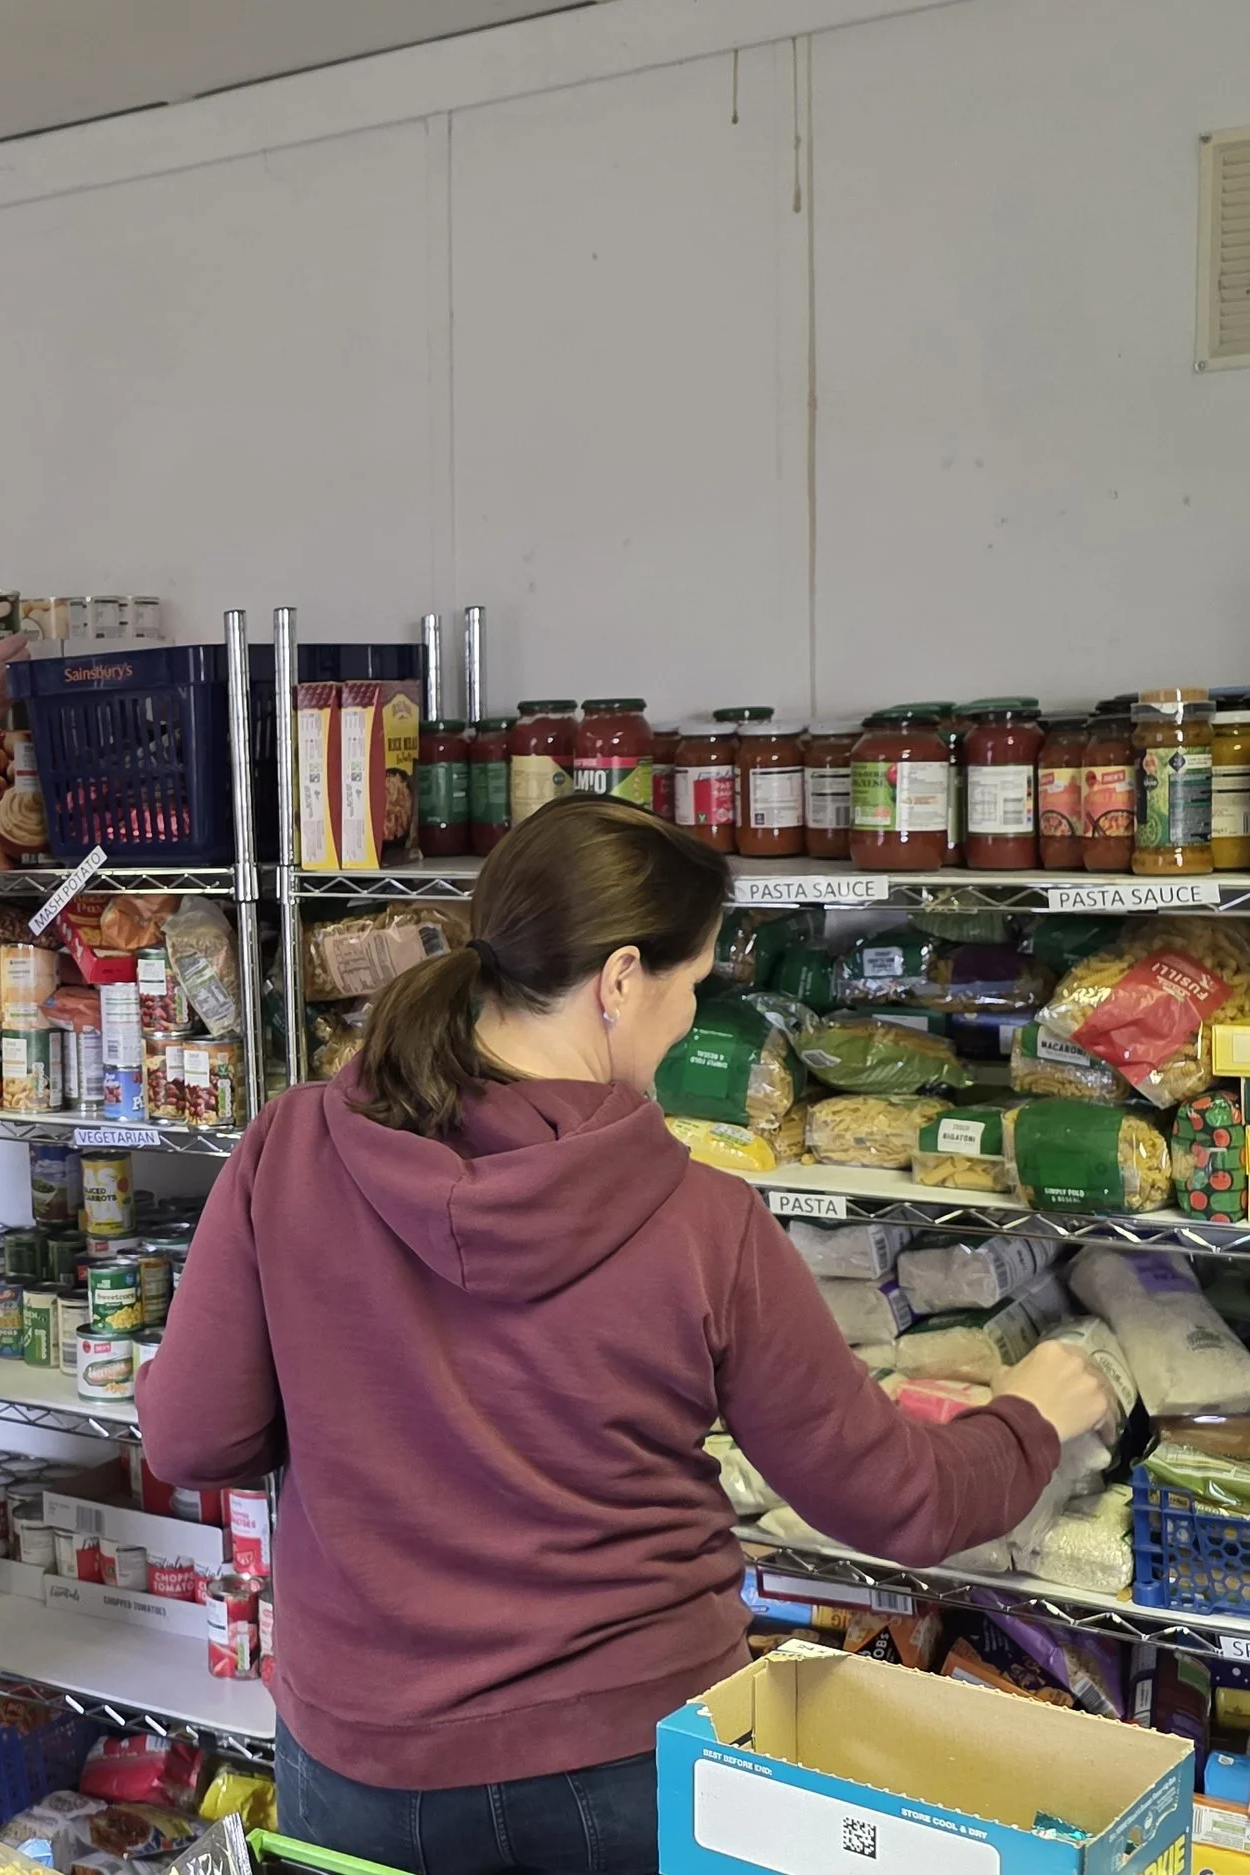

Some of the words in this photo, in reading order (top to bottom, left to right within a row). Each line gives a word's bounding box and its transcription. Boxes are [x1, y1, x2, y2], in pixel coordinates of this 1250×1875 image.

[65, 662, 133, 683] Sainsbury's
[34, 899, 63, 929] MASH
[65, 852, 101, 898] POTATO
[750, 883, 807, 899] PASTA
[813, 881, 875, 897] SAUCE
[1060, 891, 1125, 908] PASTA
[1131, 886, 1201, 905] SAUCE
[1152, 963, 1209, 1001] FUSILLI
[79, 1130, 156, 1144] VEGETARIAN
[779, 1197, 838, 1216] PASTA
[104, 1596, 132, 1610] CHOPPED
[134, 1601, 167, 1617] TOMATOES
[703, 1748, 722, 1760] BEST
[723, 1752, 753, 1770] BEFORE
[754, 1760, 773, 1776] END:
[901, 1807, 932, 1823] STORE
[933, 1816, 958, 1832] COOL
[959, 1825, 967, 1833] &
[968, 1827, 989, 1840] DRY
